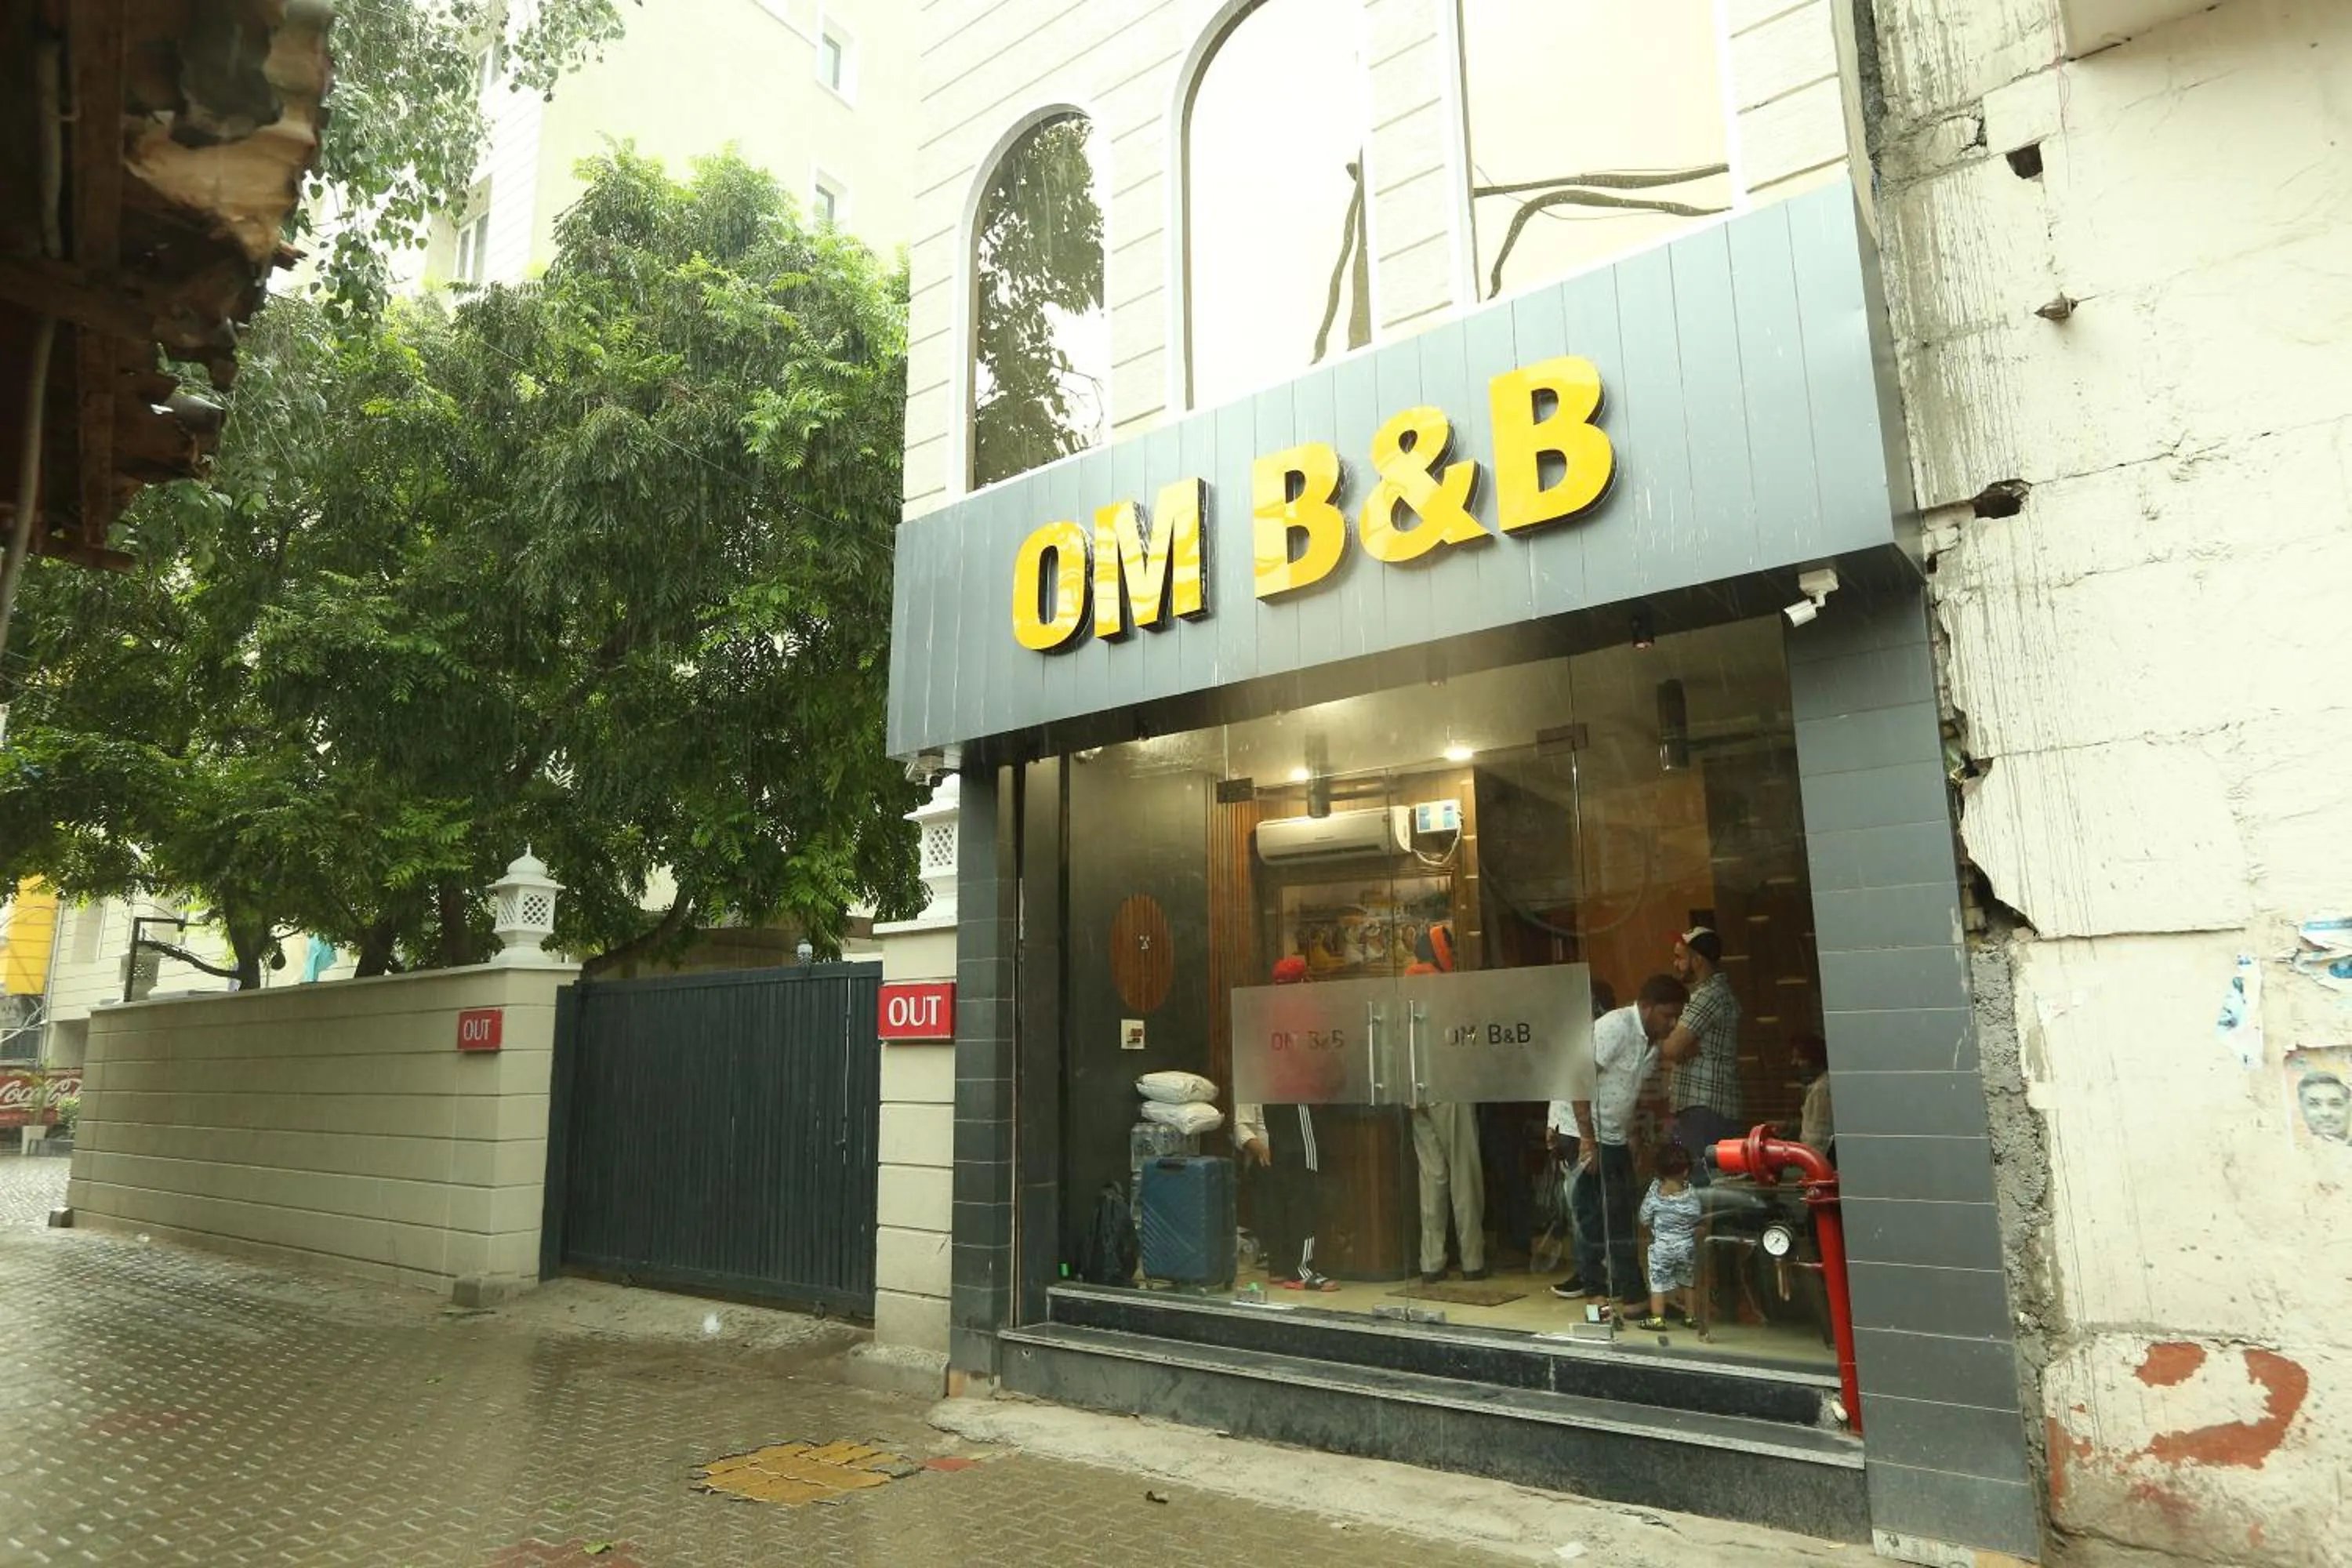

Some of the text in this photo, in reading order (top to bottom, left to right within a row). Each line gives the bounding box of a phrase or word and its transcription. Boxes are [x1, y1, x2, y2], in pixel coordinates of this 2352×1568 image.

[1011, 355, 1617, 655] OM B&B
[887, 995, 942, 1027] OUT
[463, 1018, 492, 1041] OUT
[1487, 1022, 1531, 1045] B&B
